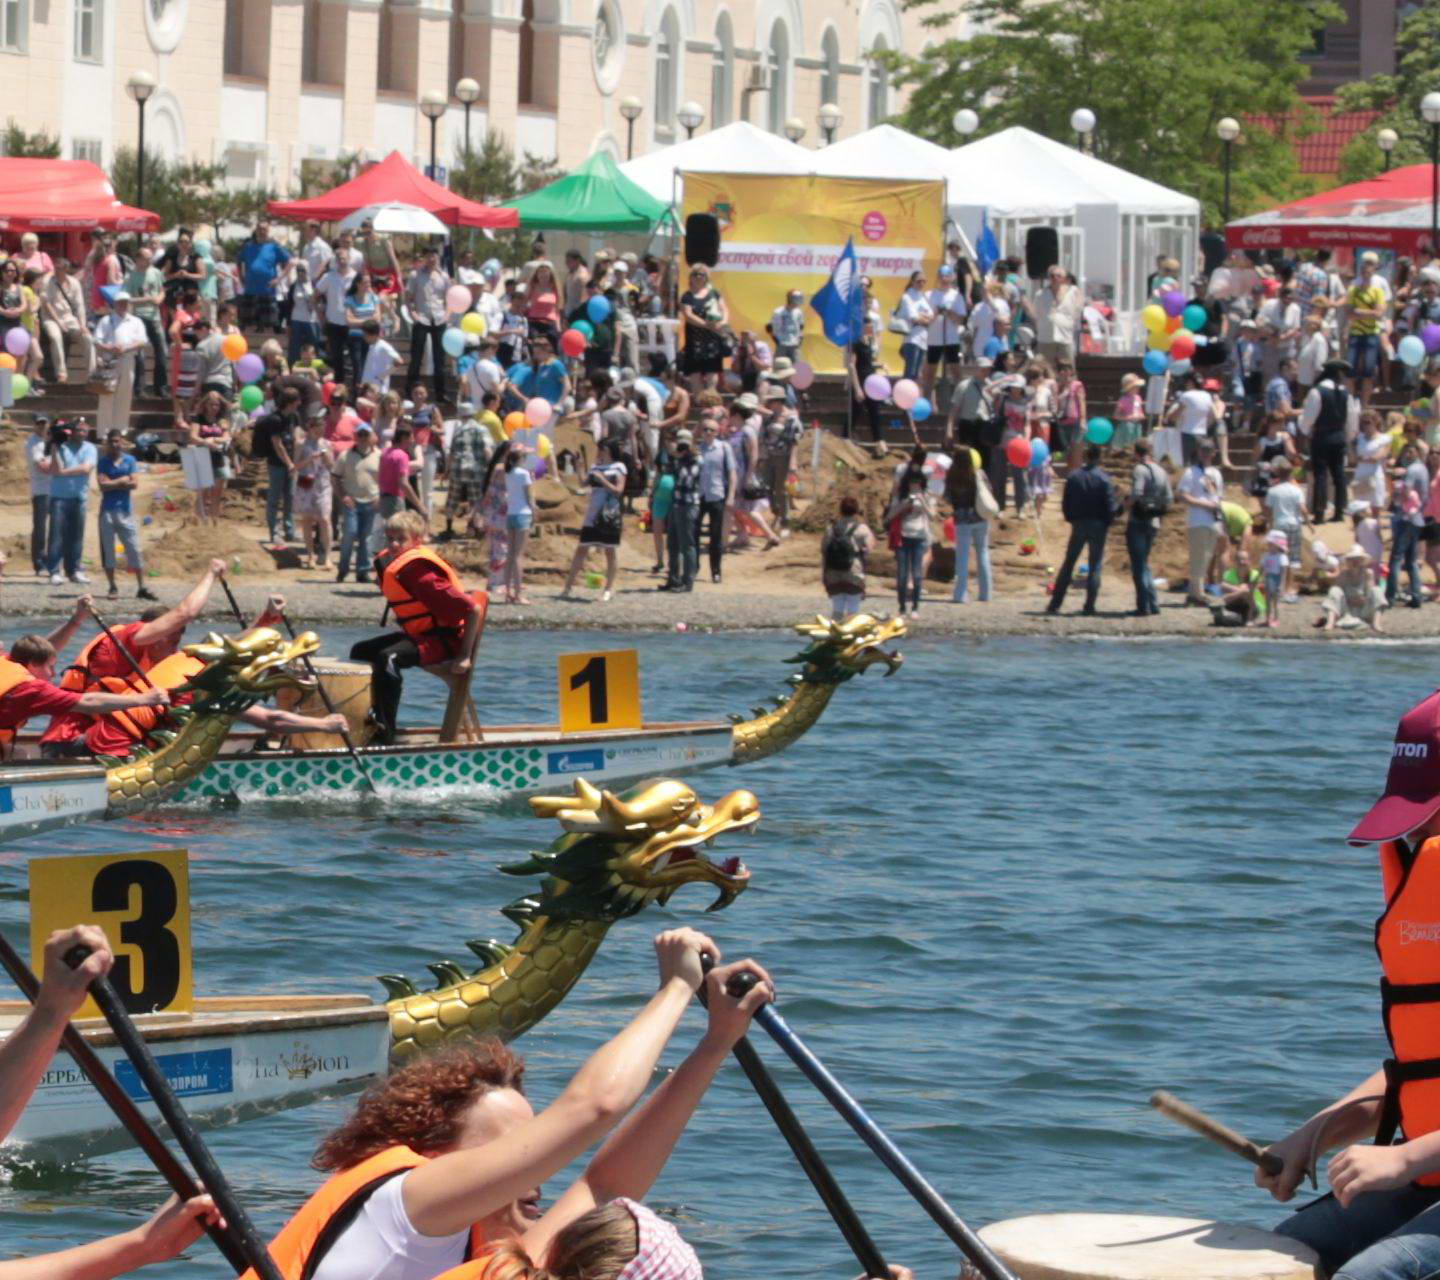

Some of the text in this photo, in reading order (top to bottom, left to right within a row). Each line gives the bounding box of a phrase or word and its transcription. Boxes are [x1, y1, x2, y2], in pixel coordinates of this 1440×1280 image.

[719, 249, 778, 269] острой
[570, 656, 608, 724] 1
[92, 859, 180, 1015] 3
